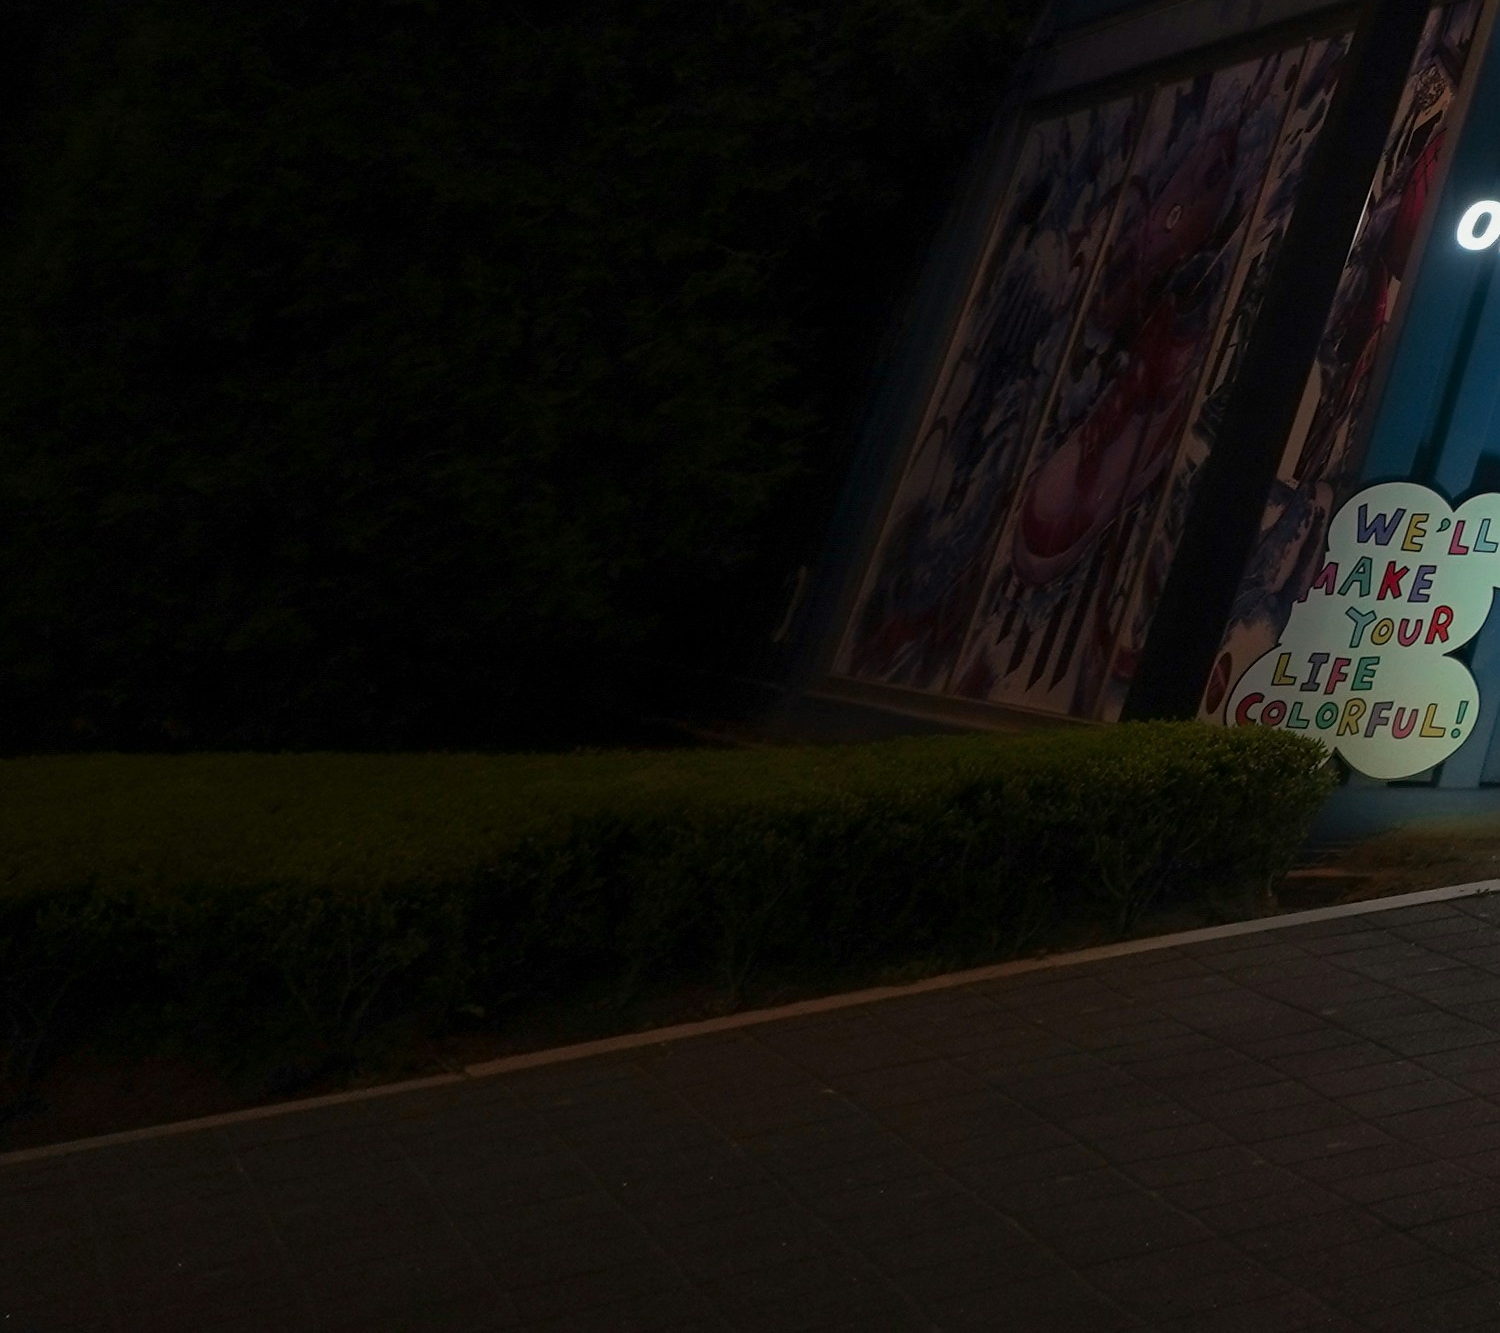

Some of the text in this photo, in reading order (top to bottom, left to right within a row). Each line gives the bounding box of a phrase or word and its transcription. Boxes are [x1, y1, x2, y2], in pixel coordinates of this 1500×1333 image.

[1298, 556, 1437, 603] MAKE
[1345, 605, 1454, 649] YOUR
[1271, 652, 1381, 695] LIFE
[1235, 692, 1469, 740] COLORFUL!
